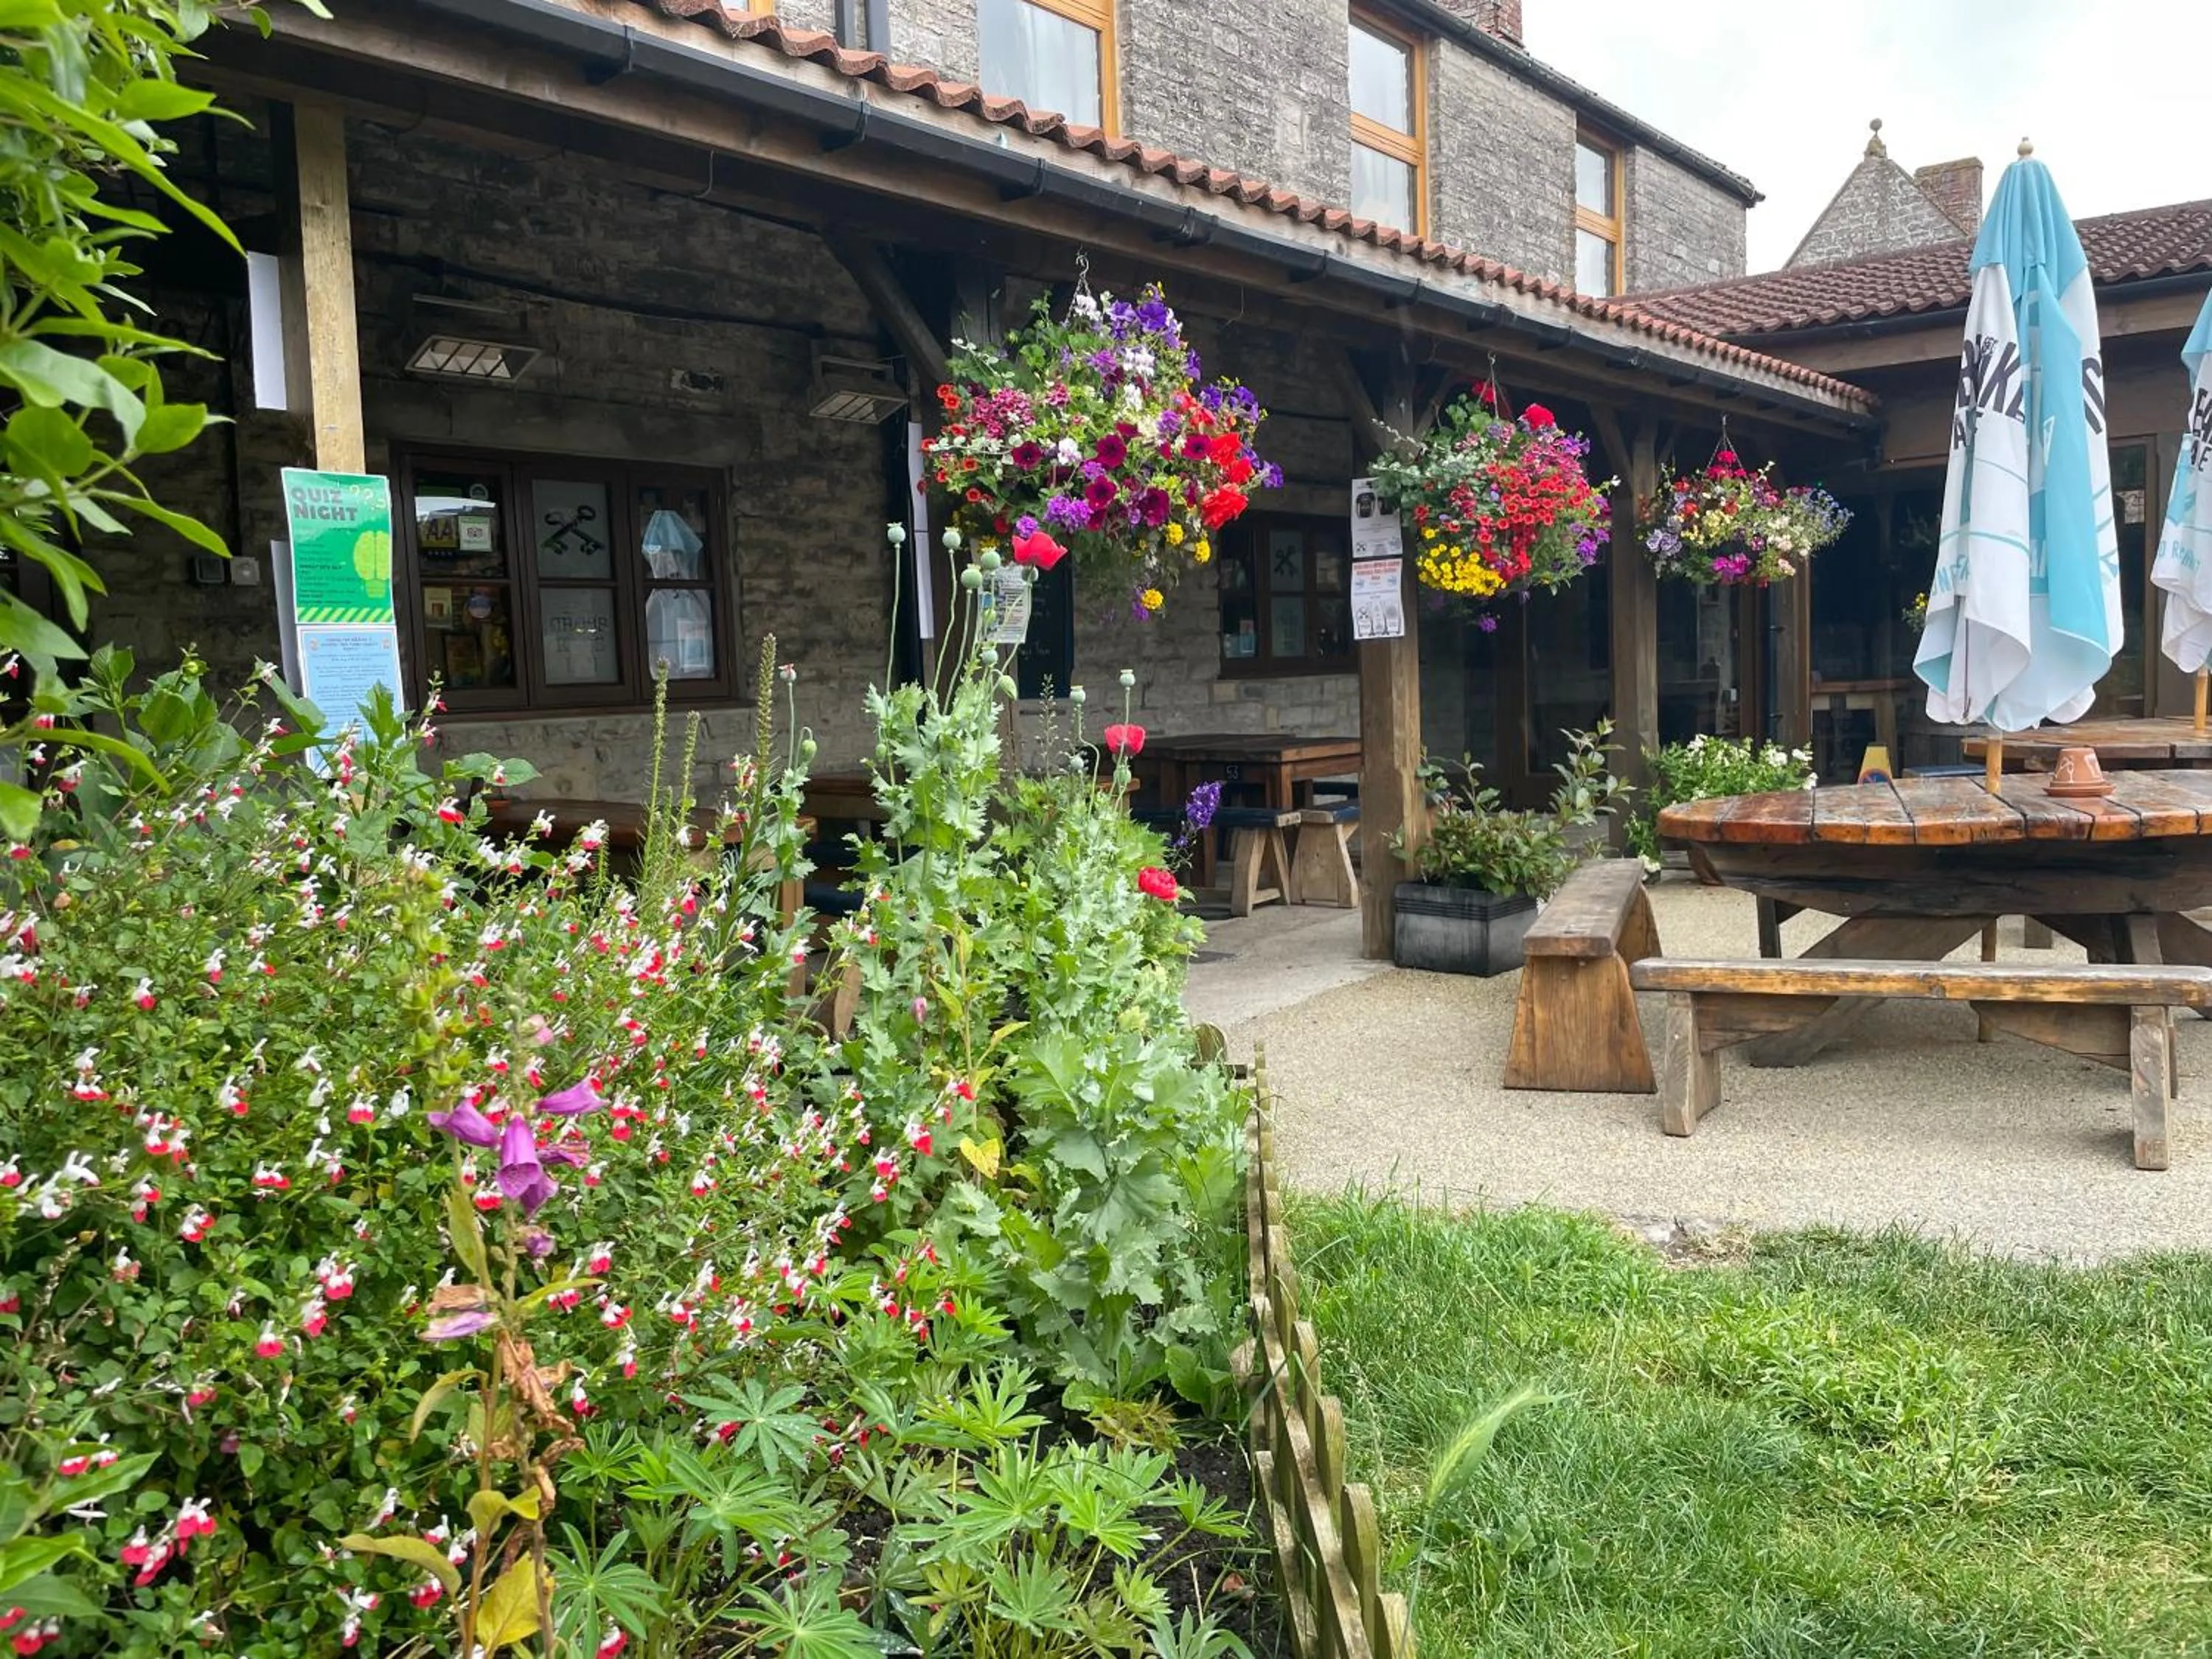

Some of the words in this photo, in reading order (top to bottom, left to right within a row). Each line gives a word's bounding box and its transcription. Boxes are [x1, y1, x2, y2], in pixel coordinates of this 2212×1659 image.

[291, 487, 343, 504] QUIZ
[293, 504, 358, 521] NIGHT
[1226, 765, 1239, 779] 53
